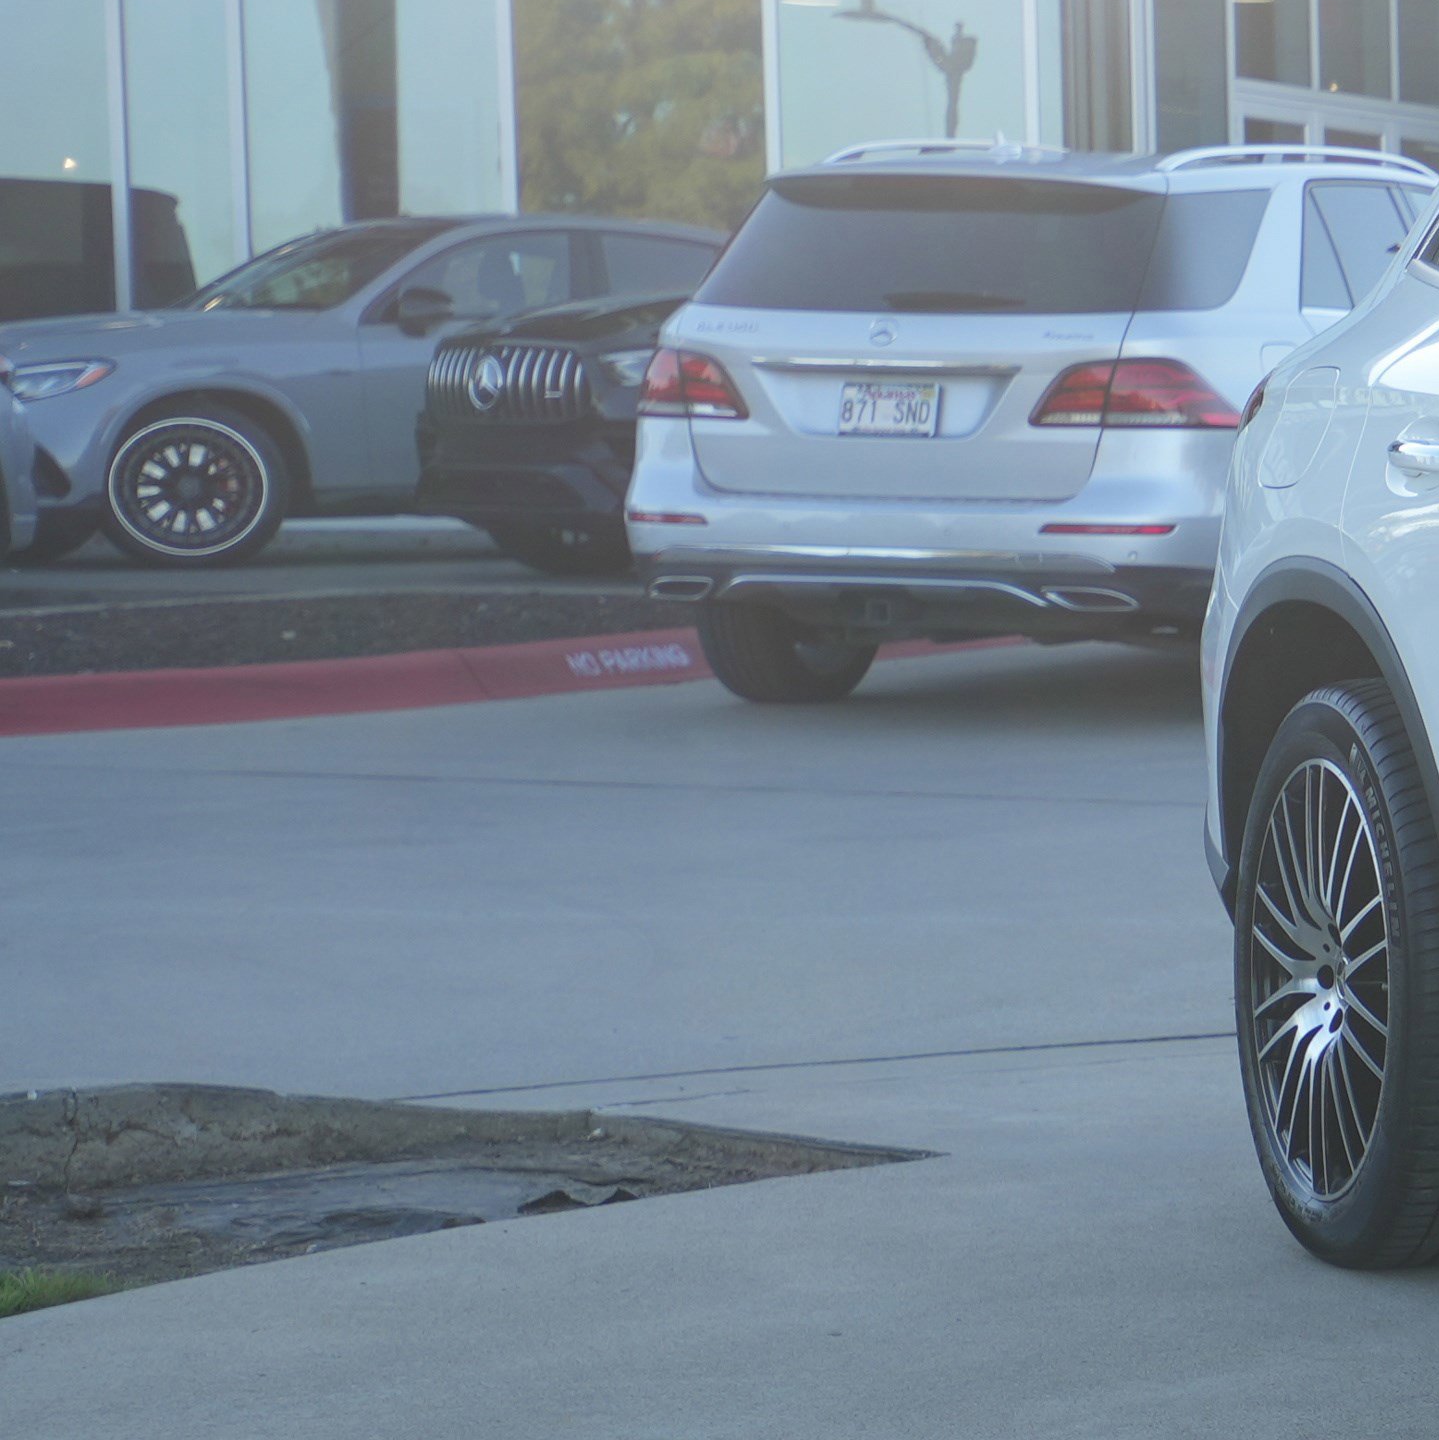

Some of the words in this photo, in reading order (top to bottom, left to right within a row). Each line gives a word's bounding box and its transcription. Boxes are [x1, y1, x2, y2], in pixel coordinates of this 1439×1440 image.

[841, 398, 878, 424] 871
[892, 400, 931, 425] SND
[565, 650, 602, 677] NO
[598, 642, 692, 674] PARKING
[1363, 786, 1402, 941] MICHELIN
